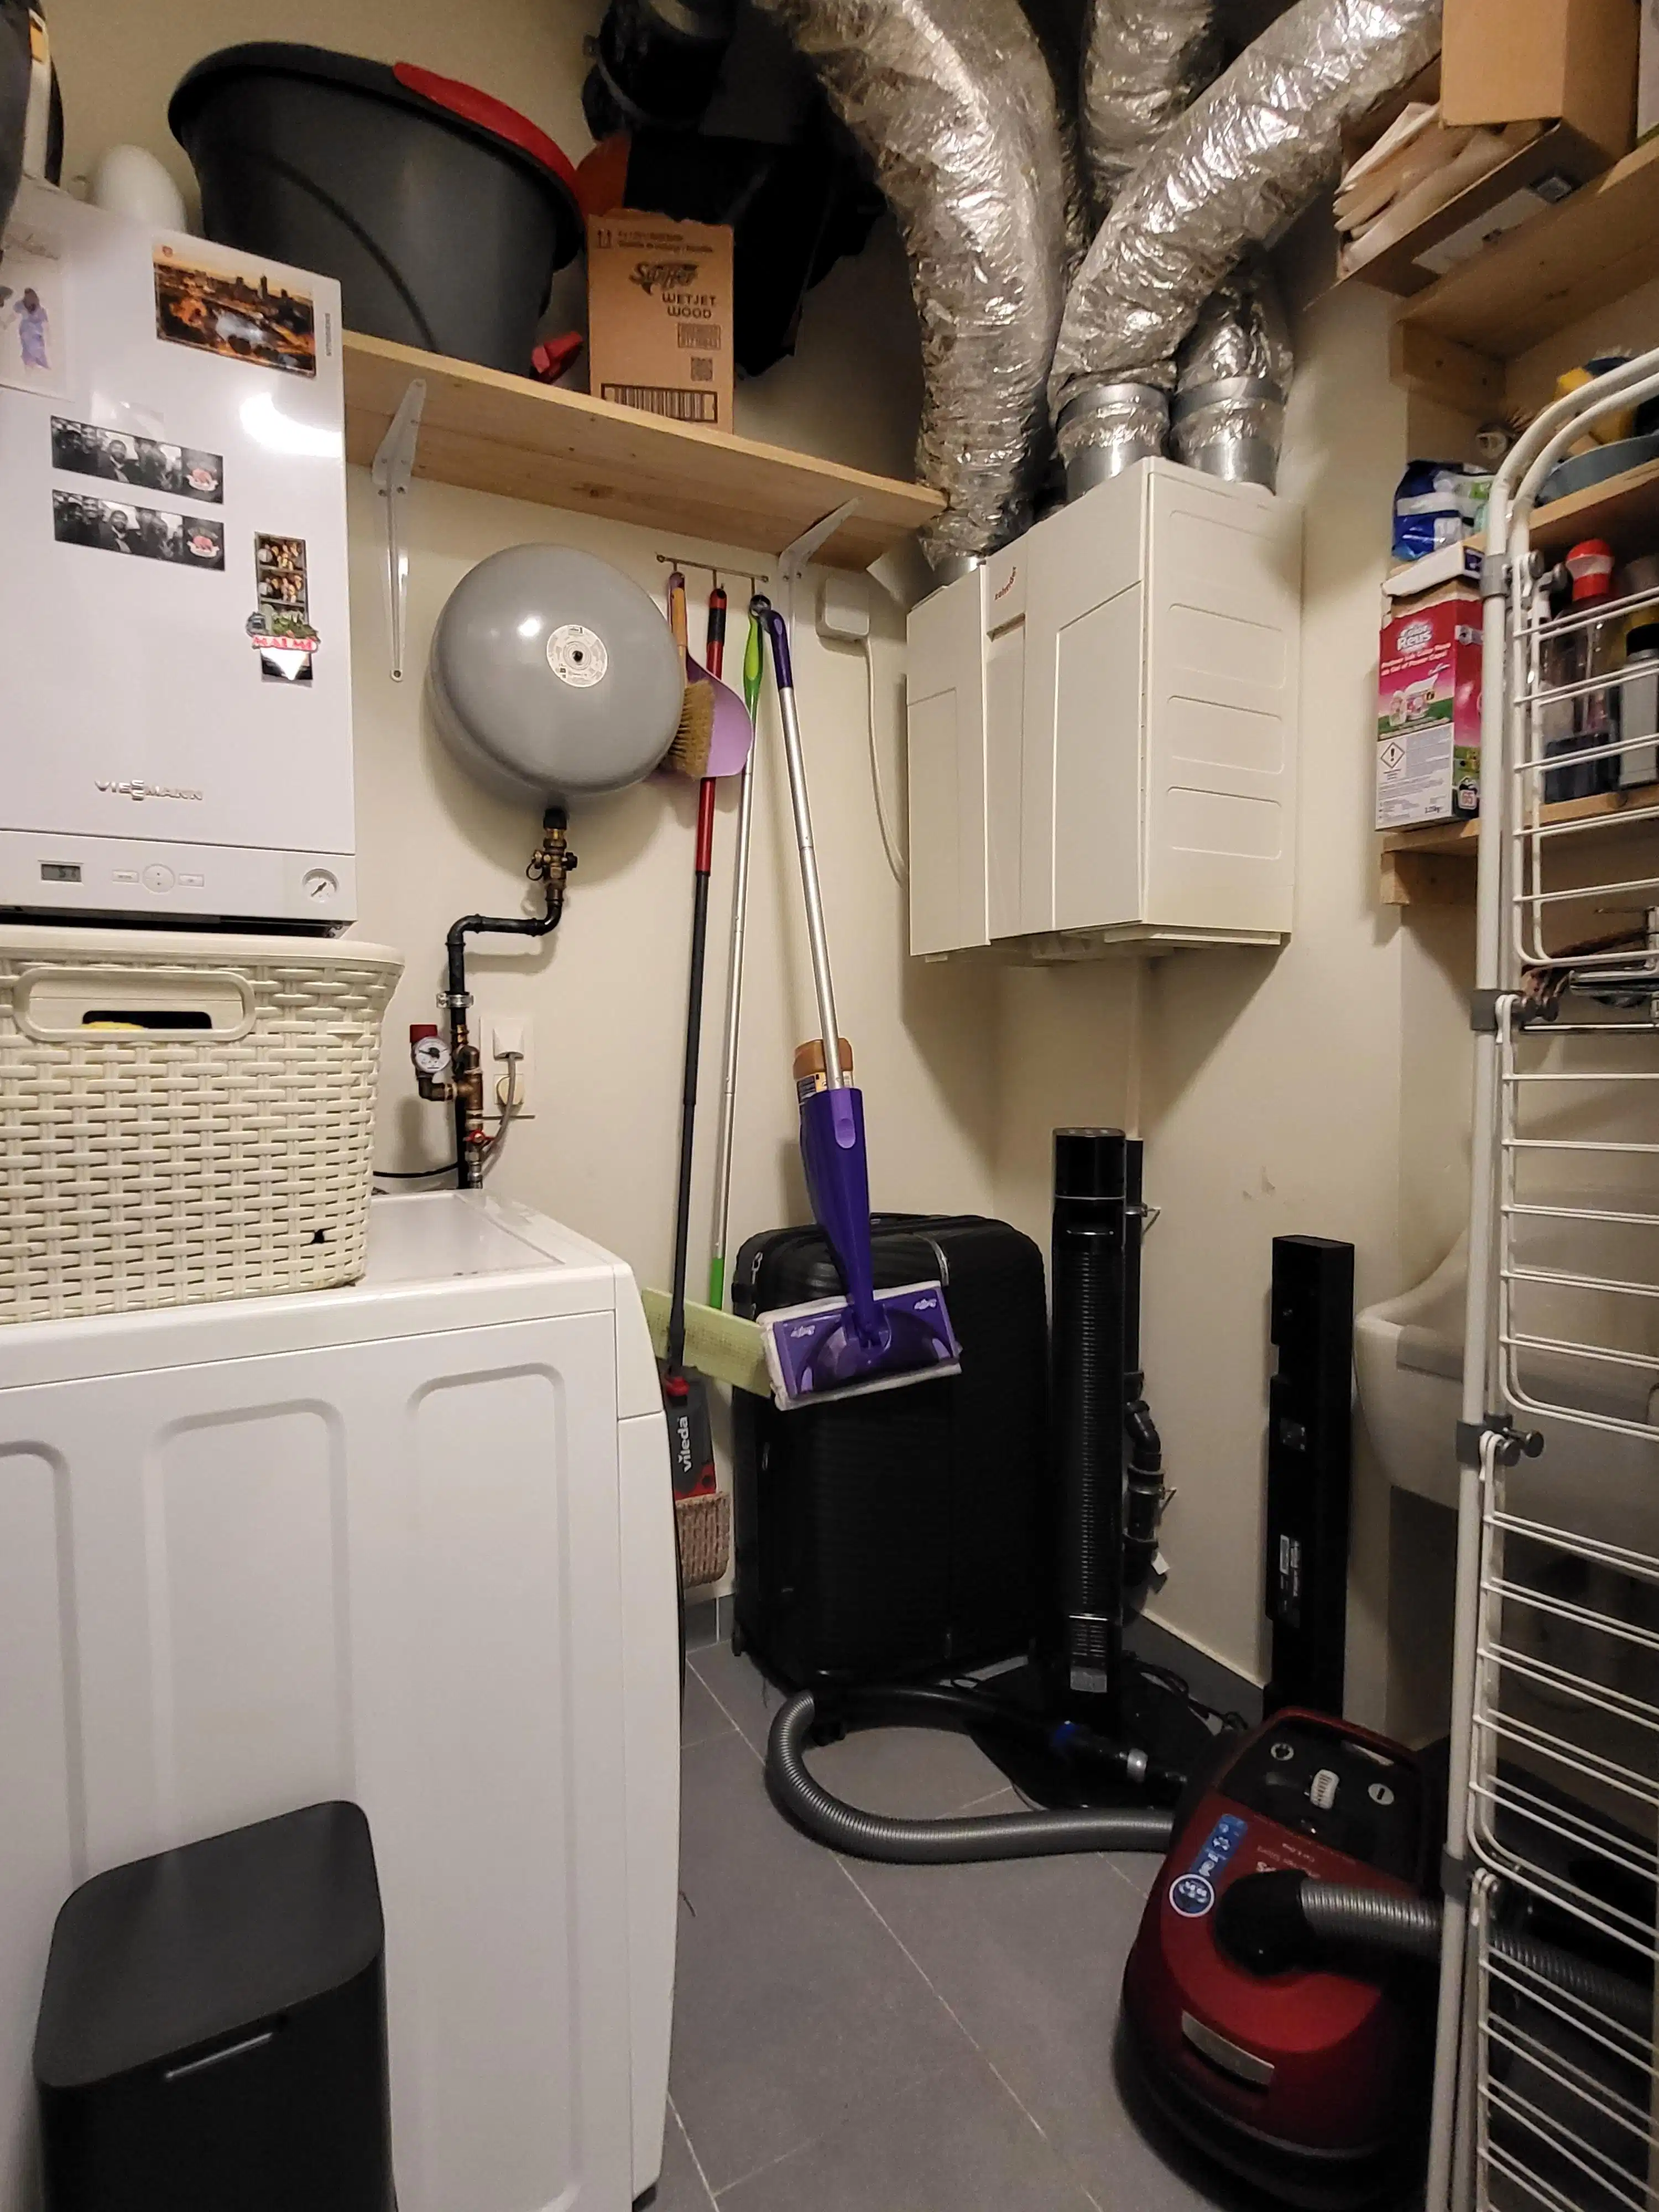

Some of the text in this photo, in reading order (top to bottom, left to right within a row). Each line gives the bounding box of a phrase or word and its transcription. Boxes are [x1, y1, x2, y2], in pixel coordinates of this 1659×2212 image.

[662, 293, 716, 306] WETJET
[667, 306, 712, 319] WOOD
[1397, 631, 1432, 651] Reus
[677, 1416, 692, 1473] vileda
